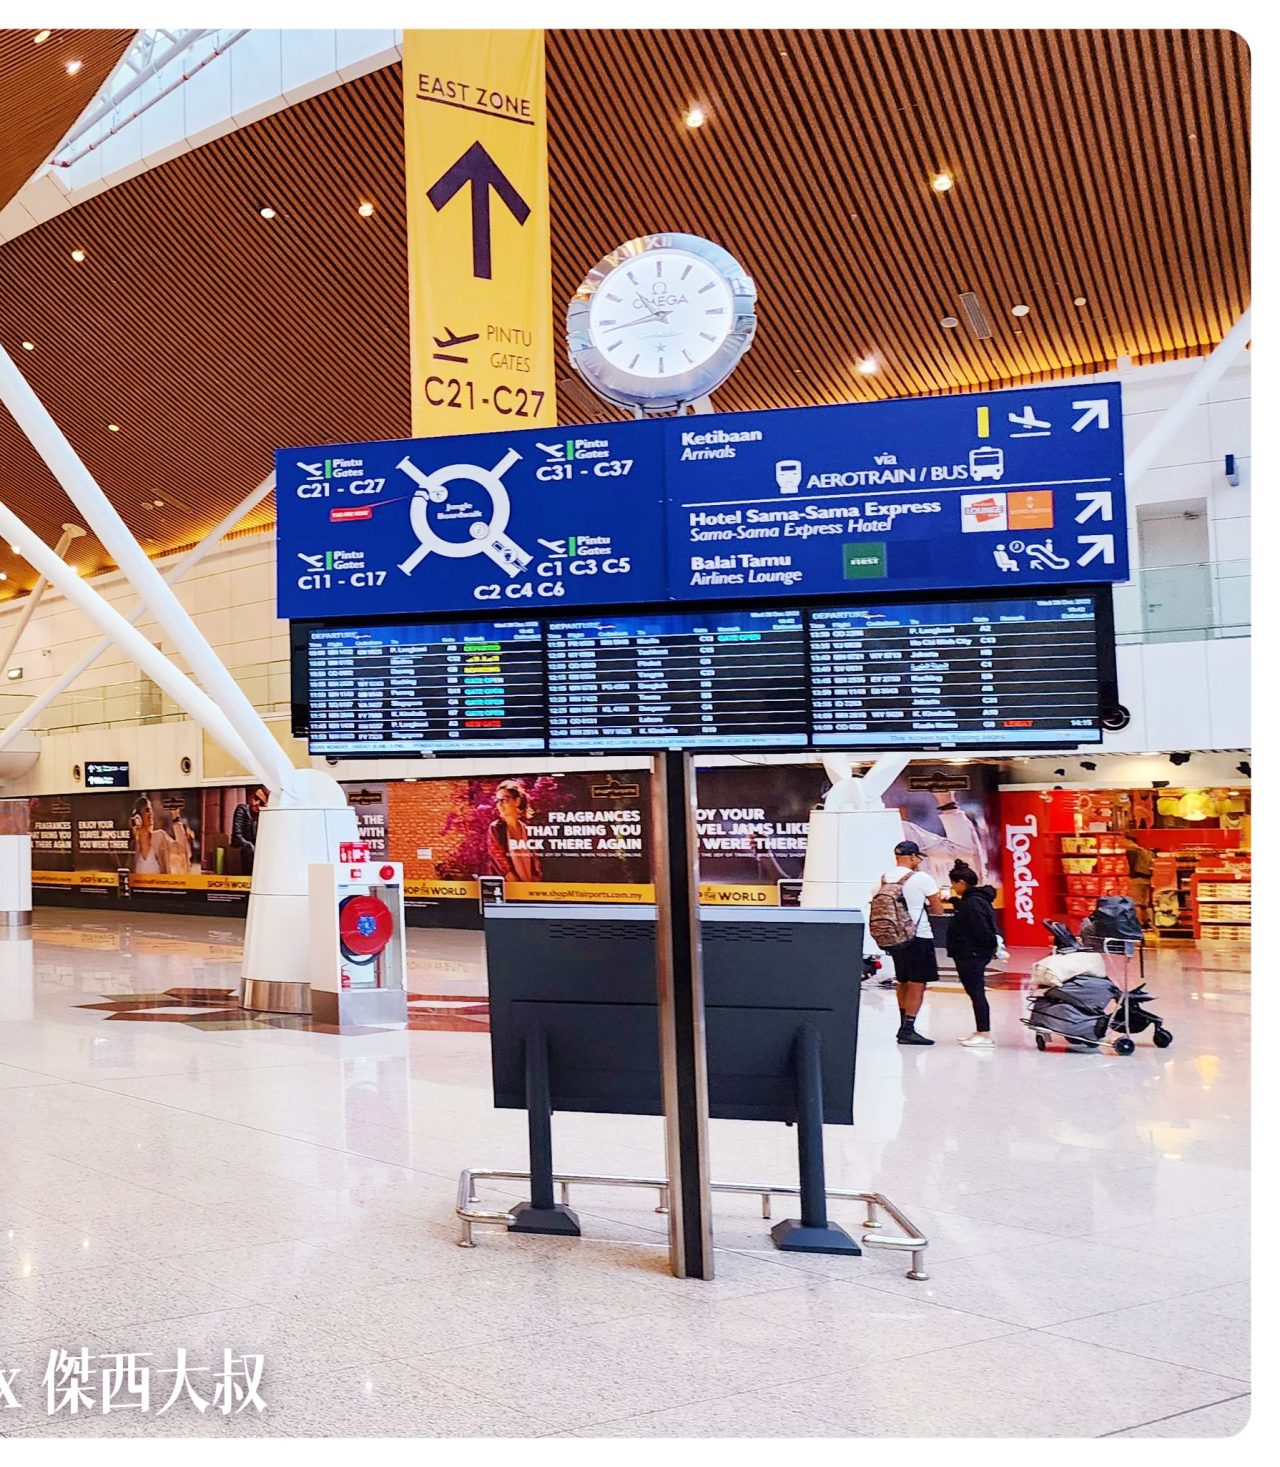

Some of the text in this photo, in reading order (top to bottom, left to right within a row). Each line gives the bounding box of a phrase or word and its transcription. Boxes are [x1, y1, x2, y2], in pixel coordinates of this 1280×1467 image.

[418, 74, 531, 117] EAST ZONE
[632, 294, 688, 309] OMEGA
[487, 325, 532, 347] PINTU
[490, 352, 530, 373] GATES
[424, 376, 544, 418] C21-C27
[681, 428, 762, 446] Ketibaan
[575, 439, 608, 449] Pintu
[575, 449, 609, 460] Gates
[681, 445, 736, 461] Arrivals
[874, 452, 897, 465] via
[332, 457, 363, 468] Pintu
[332, 467, 364, 478] Gates
[536, 464, 572, 481] C31
[594, 460, 633, 477] C37
[806, 467, 916, 489] AEROTRAIN
[931, 464, 968, 481] BUS
[297, 482, 330, 498] C21
[349, 479, 386, 495] C27
[690, 500, 941, 527] Hotel Sama-Sama Express
[690, 517, 892, 542] Sama-Sama Express Hotel
[577, 536, 610, 546] Pintu
[333, 550, 364, 560] Pintu
[577, 545, 611, 556] Gates
[333, 559, 365, 570] Gates
[537, 558, 631, 577] C1 C3 C5
[691, 554, 791, 571] Balai Tamu
[297, 574, 331, 589] C11
[350, 572, 387, 587] C17
[690, 569, 802, 587] Airlines Lounge
[474, 581, 565, 600] C2 C4 C6
[812, 611, 868, 620] DEPARTURE
[362, 815, 384, 825] THE
[548, 810, 640, 823] FRAGRANCES
[719, 808, 765, 820] YOUR
[526, 824, 641, 837] THAT BRING YOU
[728, 822, 773, 835] JAMS
[776, 822, 810, 834] LIKE
[508, 838, 641, 851] BACK THERE AGAIN
[703, 837, 807, 850] WERE THERE
[1006, 814, 1040, 925] Loacker
[430, 886, 467, 896] WORLD
[719, 892, 766, 902] WORLD
